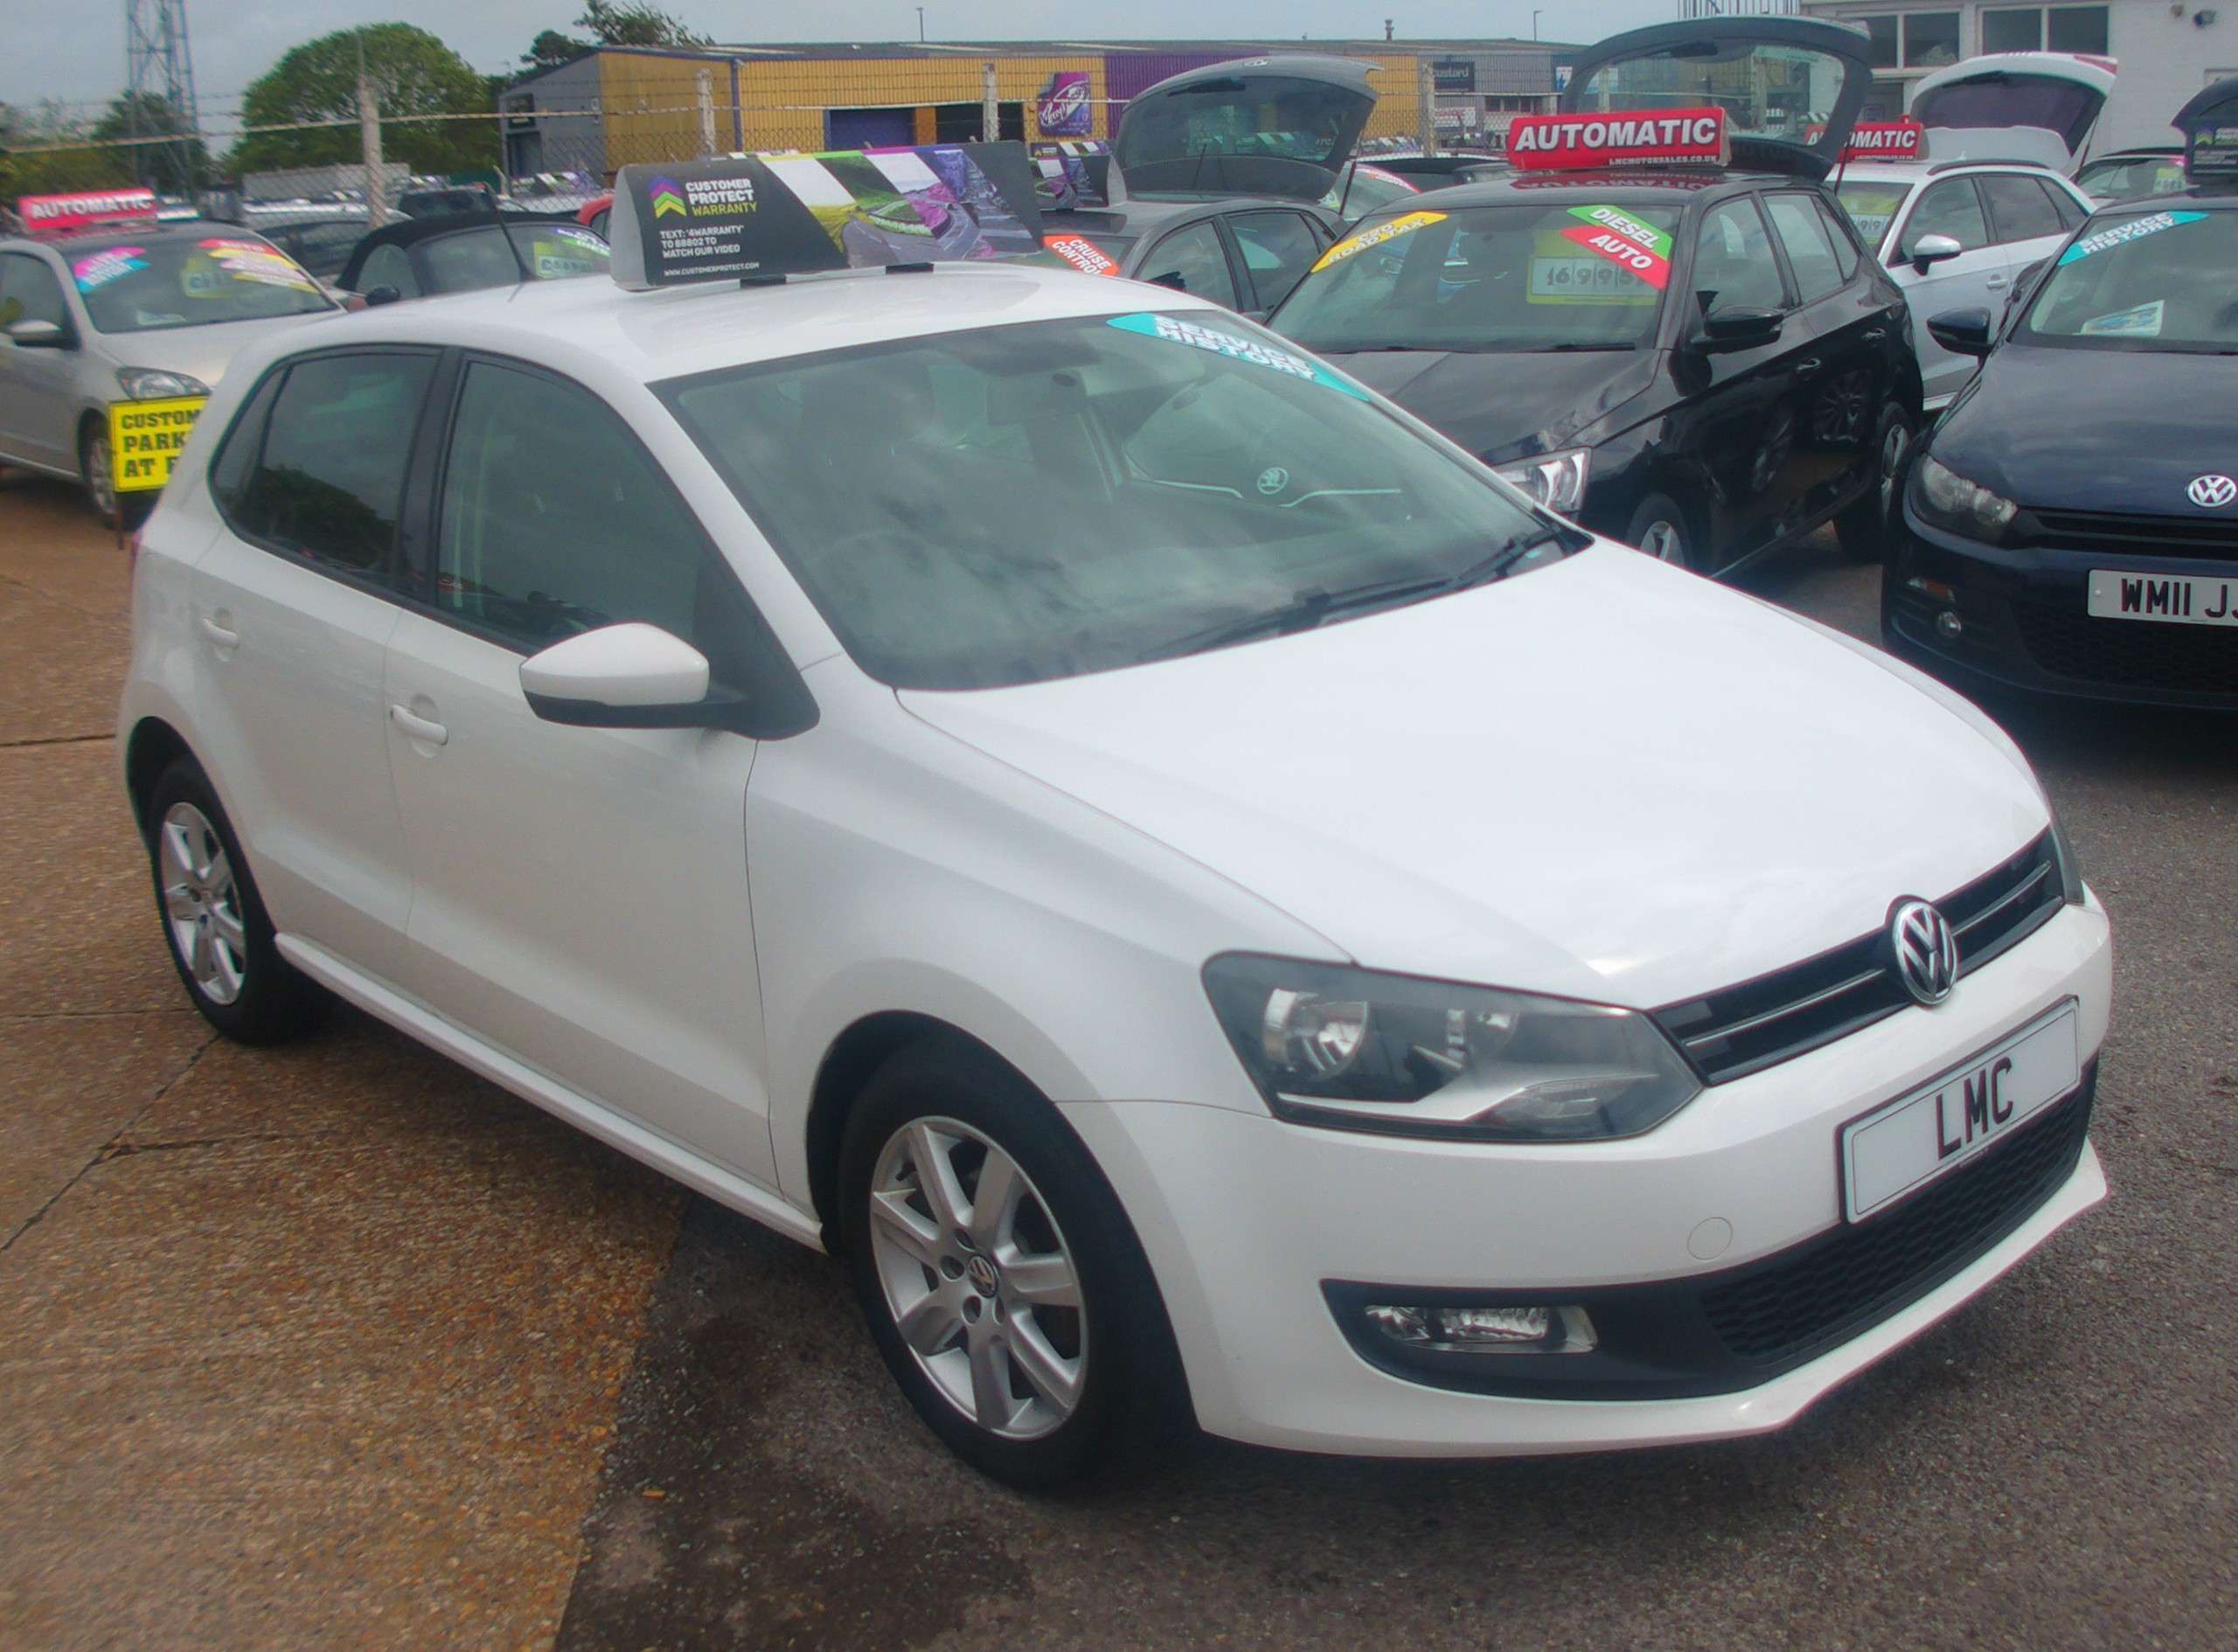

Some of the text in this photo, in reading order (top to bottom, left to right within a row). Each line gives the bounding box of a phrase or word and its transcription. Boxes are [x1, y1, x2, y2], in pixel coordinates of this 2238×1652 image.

[1514, 117, 1716, 152] AUTOMATIC
[685, 178, 752, 192] CUSTOMER
[688, 189, 754, 205] PROTECT
[31, 195, 152, 219] AUTOMATIC
[692, 202, 758, 217] WARRANTY
[660, 230, 686, 239] TEXT:
[661, 239, 673, 249] TO
[1589, 208, 1659, 248] DIESEL
[2079, 212, 2172, 247] SERVICE
[2083, 218, 2175, 254] HISTORY
[663, 245, 740, 259] WATCH OUR VIDEO
[1069, 239, 1112, 269] CRUISE
[1588, 234, 1652, 268] AUTO
[1155, 314, 1313, 372] SERVICE
[1157, 326, 1315, 381] HISTORY
[124, 458, 156, 478] AT
[2187, 475, 2236, 508] VW
[2121, 578, 2238, 620] WM11 J
[1893, 901, 1957, 1005] VW
[1936, 1057, 2014, 1161] LMC
